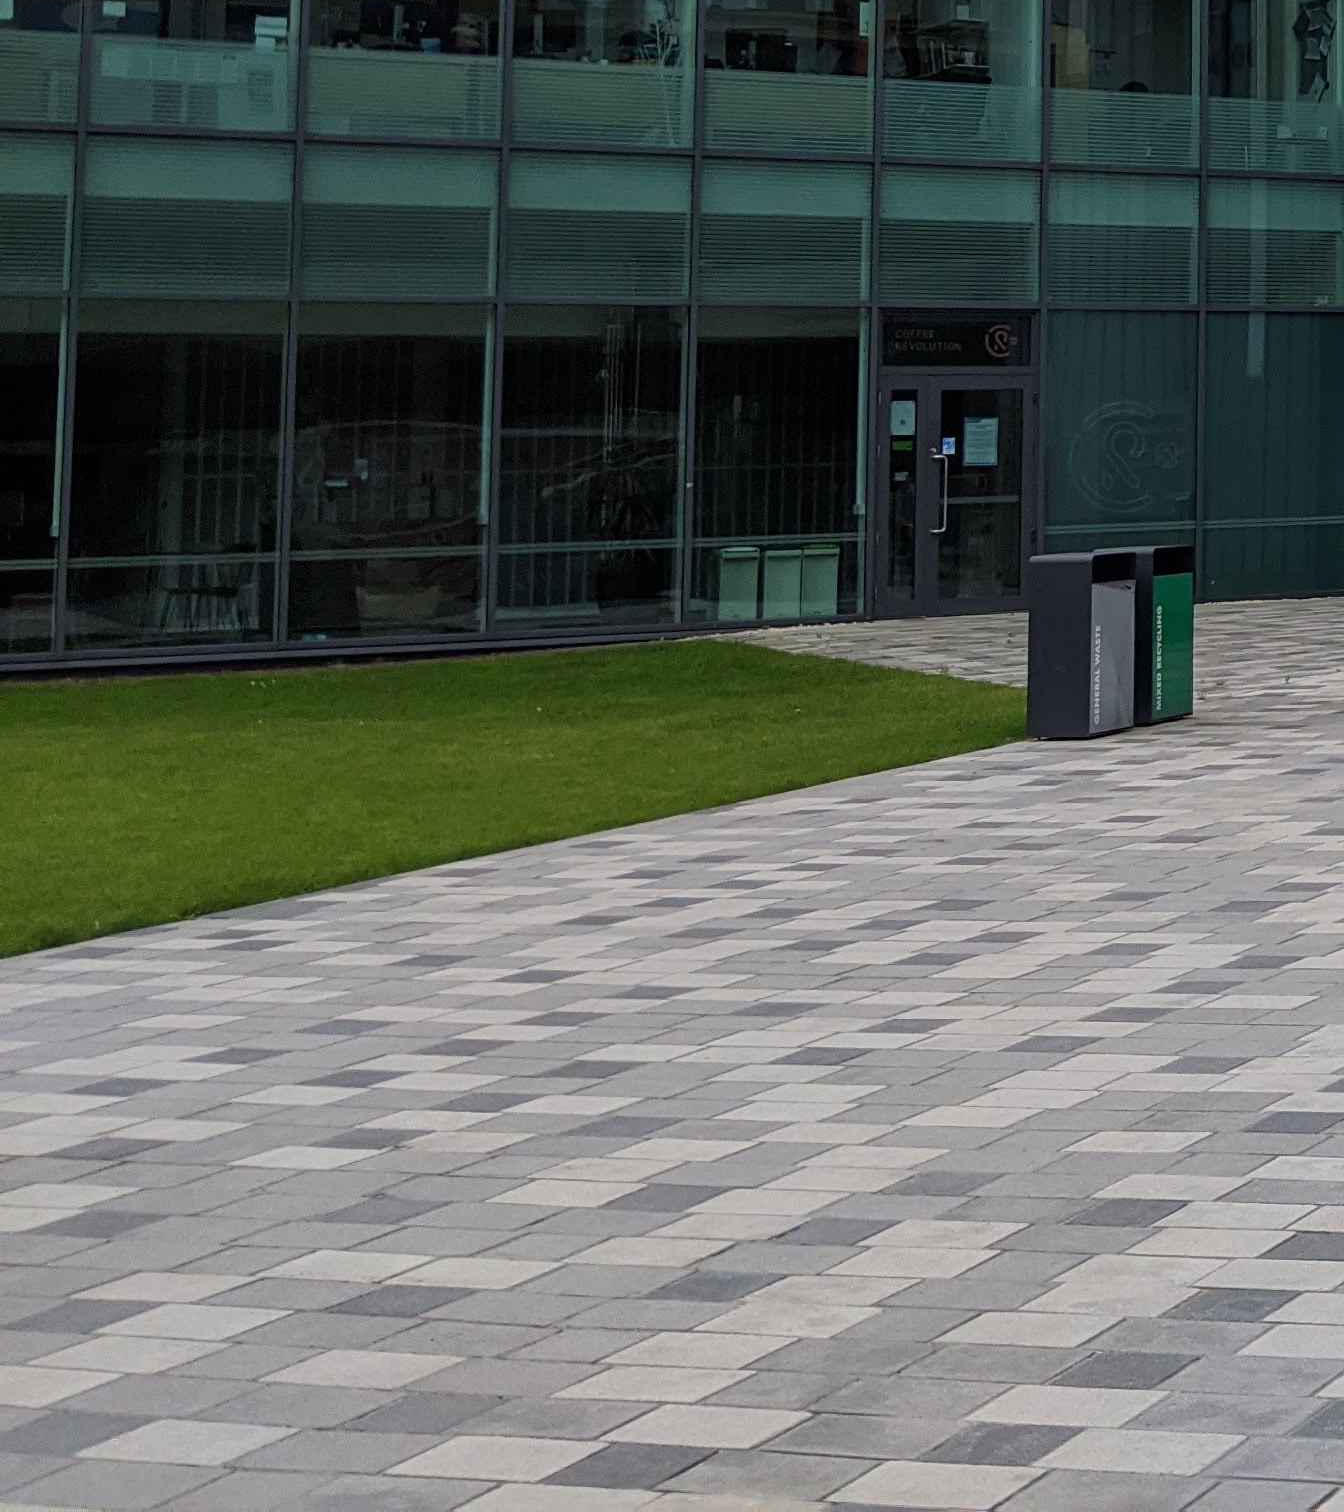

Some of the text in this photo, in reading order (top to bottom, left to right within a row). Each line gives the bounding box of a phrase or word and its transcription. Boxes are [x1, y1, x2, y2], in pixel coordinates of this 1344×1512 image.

[894, 329, 935, 339] COFFEE
[894, 341, 962, 351] REVOLUTION
[1093, 669, 1102, 725] GENERAL
